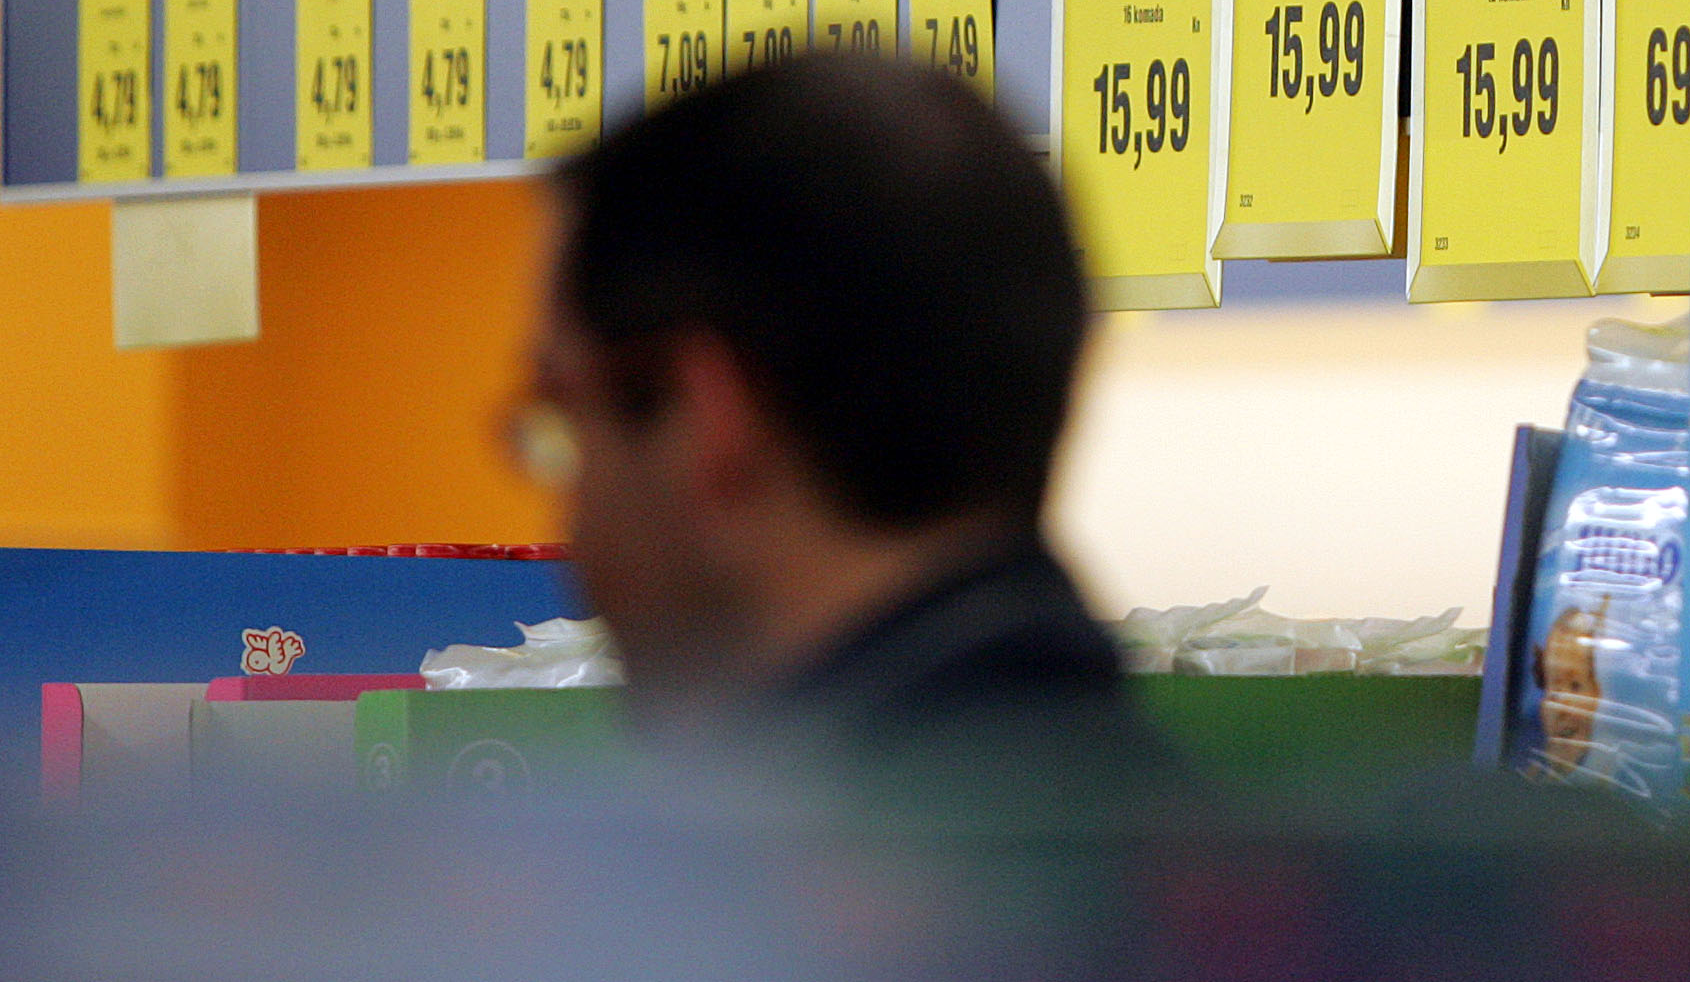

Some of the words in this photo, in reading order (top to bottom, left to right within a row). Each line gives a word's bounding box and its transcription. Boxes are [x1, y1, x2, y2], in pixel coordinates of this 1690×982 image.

[1134, 3, 1164, 23] komada
[312, 54, 357, 124] 4,79
[421, 46, 469, 116] 4,79
[540, 38, 588, 108] 4,79
[657, 30, 708, 98] 7,09
[1265, 0, 1365, 115] 15,99
[91, 69, 137, 138] 4,79
[175, 60, 221, 129] 4,79
[1093, 57, 1190, 170] 15,99
[1456, 36, 1560, 155] 15,99
